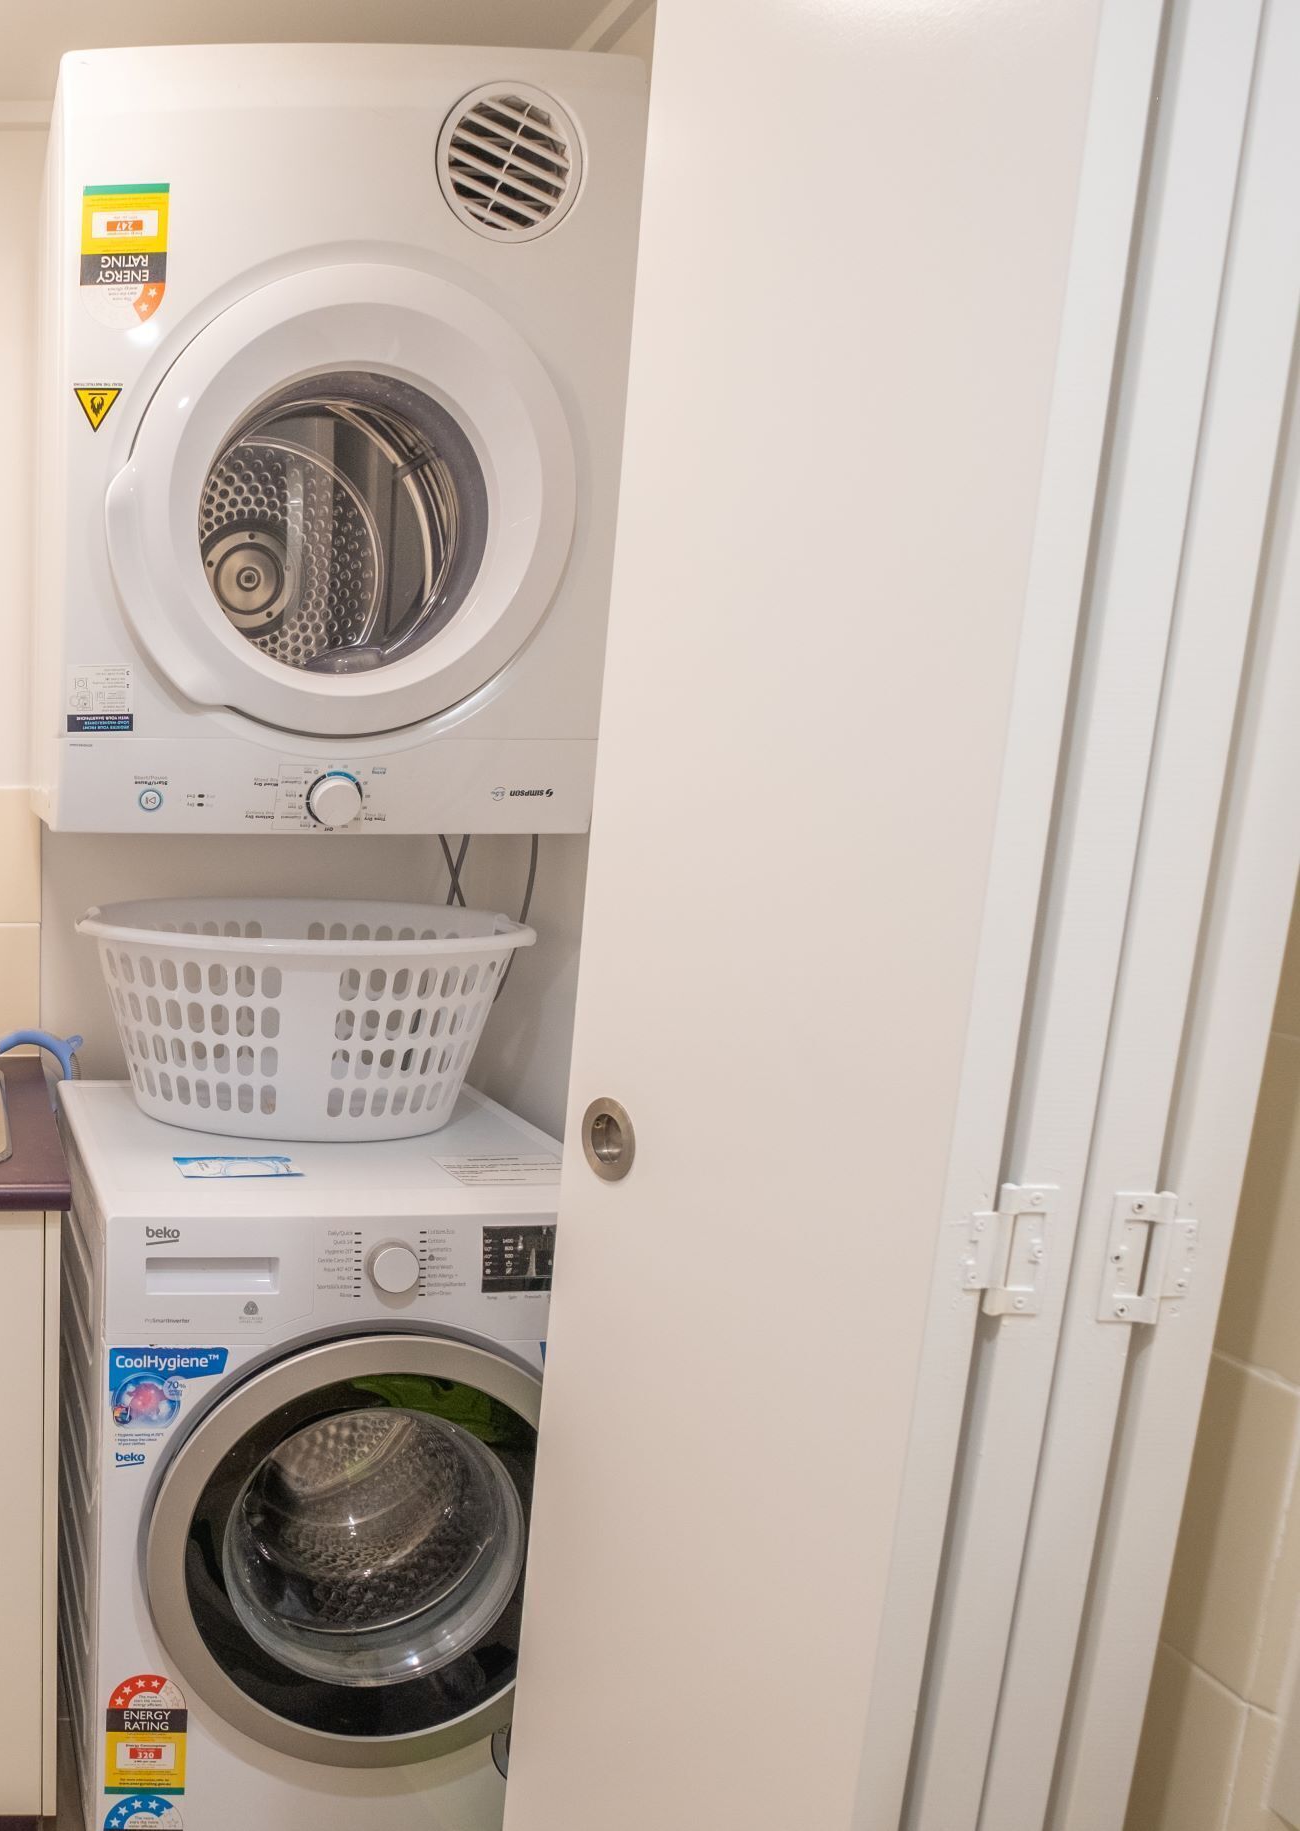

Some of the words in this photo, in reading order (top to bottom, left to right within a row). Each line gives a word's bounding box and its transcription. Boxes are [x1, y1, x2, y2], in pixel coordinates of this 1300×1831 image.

[115, 221, 134, 230] 247
[100, 254, 149, 268] RATING
[96, 269, 150, 283] ENERGY
[145, 1226, 180, 1239] beko
[115, 1452, 146, 1462] beko
[123, 1710, 171, 1720] ENERGY
[124, 1721, 170, 1731] RATING
